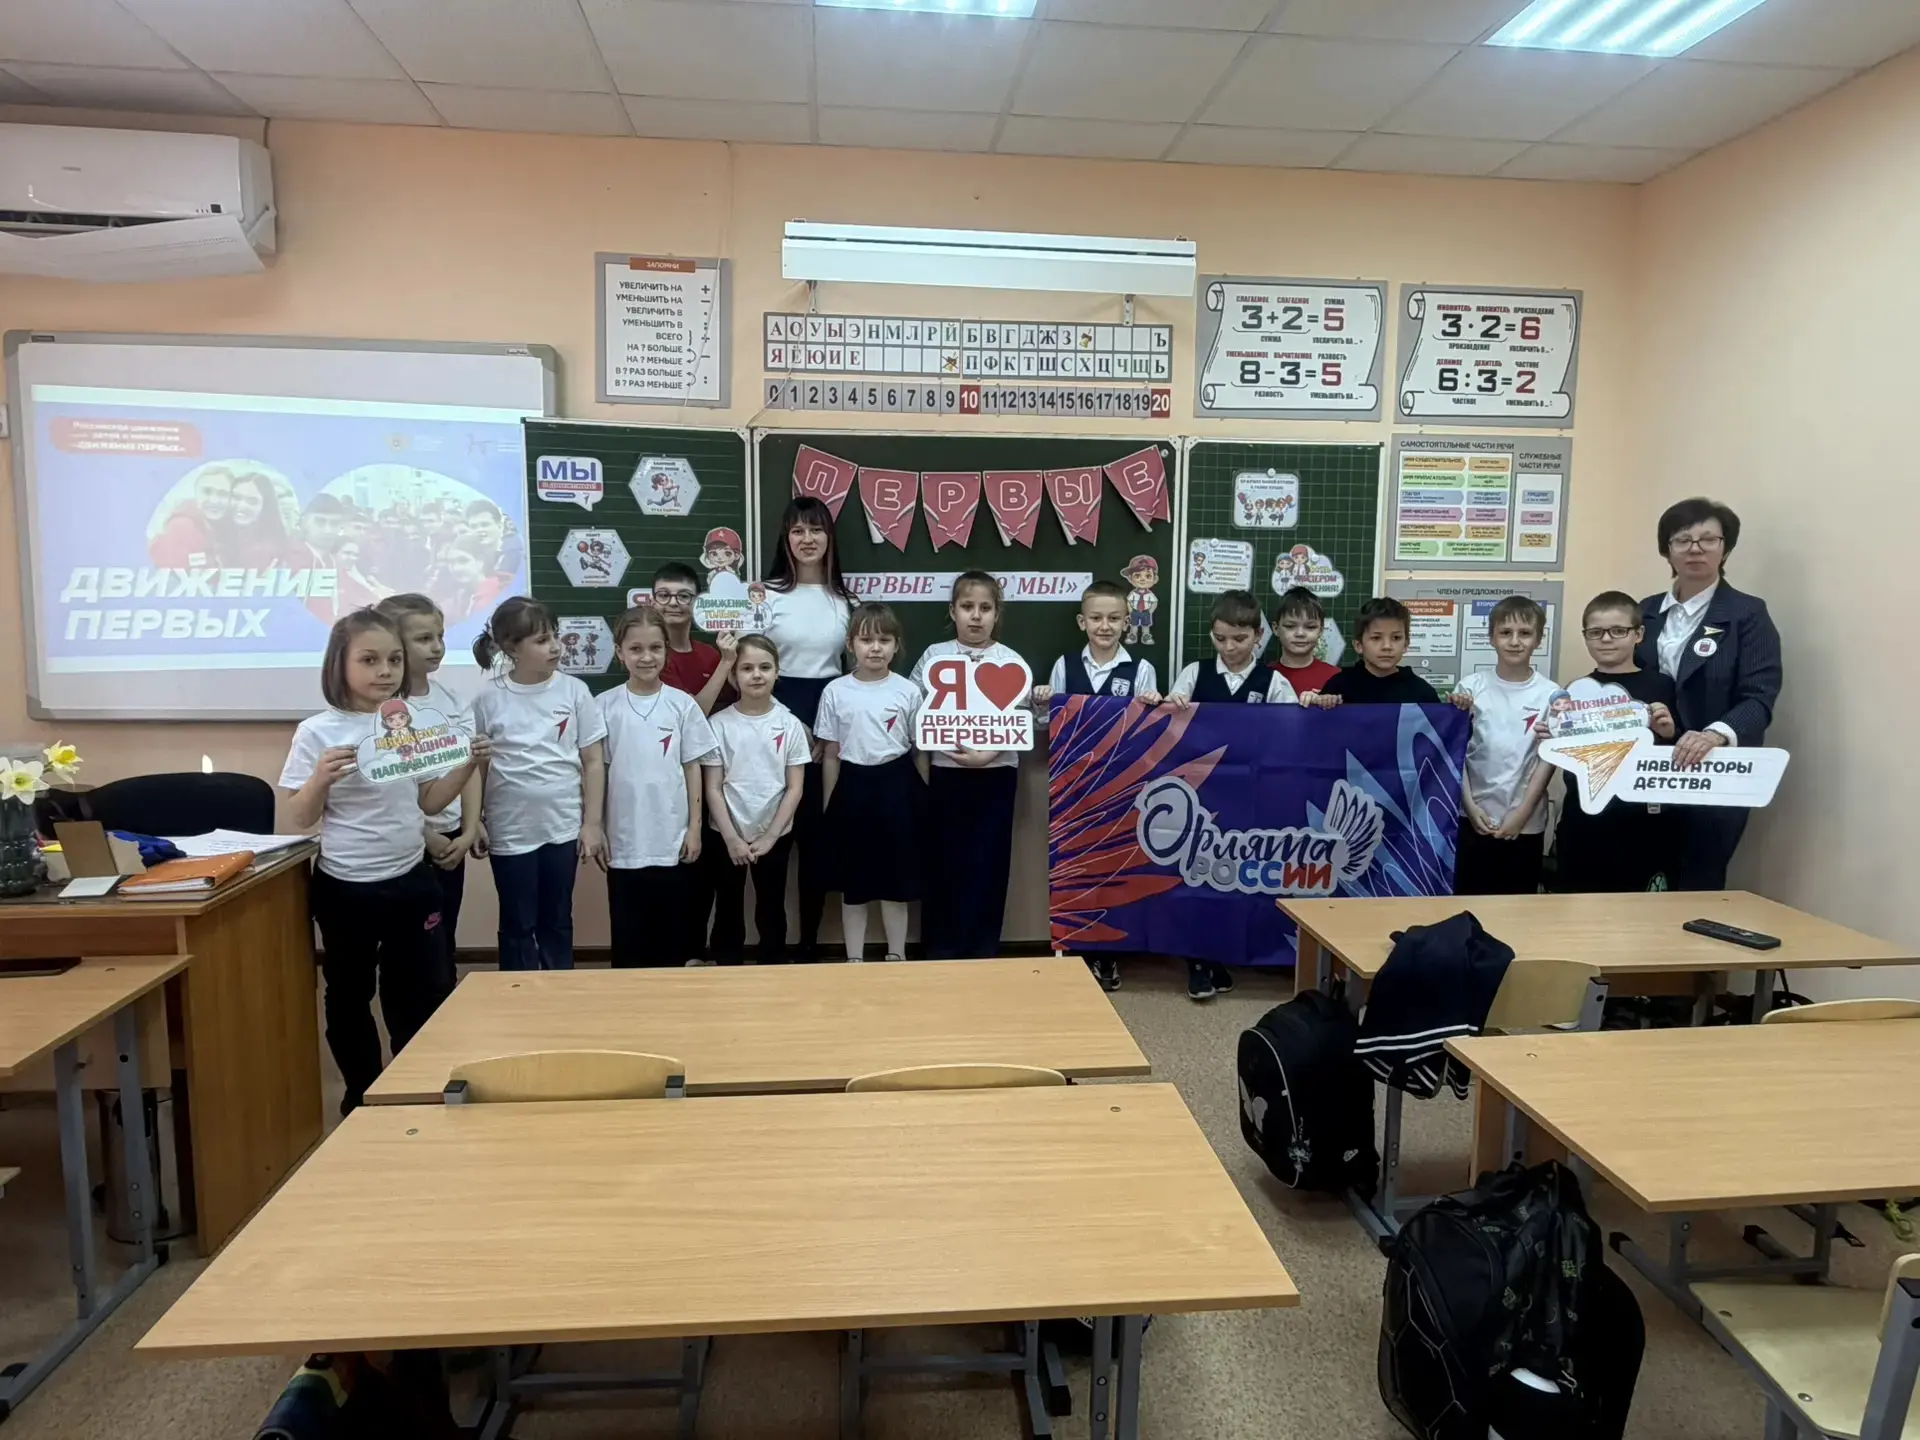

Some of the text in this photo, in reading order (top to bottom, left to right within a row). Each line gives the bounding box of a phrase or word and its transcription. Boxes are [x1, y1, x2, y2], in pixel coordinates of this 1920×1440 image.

[619, 281, 683, 292] УВЕЛИЧИТЬ НА
[616, 293, 683, 304] УМЕНЬШИТЬ НА
[626, 306, 675, 316] УВЕЛИЧИТЬ
[622, 318, 675, 329] УМЕНЬШИТЬ
[656, 332, 683, 341] ВСЕГО
[770, 321, 1167, 347] А О У Ы Э Н М Л Р Й Б В Г Д Ж З Ъ
[627, 343, 639, 351] НА
[647, 344, 683, 353] БОЛЬШЕ
[626, 355, 638, 363] НА
[647, 356, 683, 365] МЕНЬШЕ
[770, 345, 1165, 376] Я Ё Ю И Е П Ф К Т Ш С Х Ц Ч Щ Ь
[630, 367, 646, 375] РАЗ
[647, 368, 683, 377] БОЛЬШЕ
[623, 379, 627, 387] ?
[629, 380, 645, 388] РАЗ
[646, 380, 683, 389] МЕНЬШЕ
[769, 385, 1169, 412] 0 1 2 3 4 5 6 7 8 9 10 11 12 13 14 15 16 17 18 19 20
[1400, 440, 1470, 449] САМОСТОЯТЕЛЬНЫЕ
[1472, 442, 1495, 450] ЧАСТИ
[542, 460, 596, 481] МЫ
[59, 566, 338, 604] ДВИЖЕНИЕ
[1463, 588, 1514, 596] ПРЕДЛОЖЕНИЯ
[64, 607, 270, 641] ПЕРВЫХ
[928, 660, 967, 710] Я
[921, 715, 1026, 728] ДВИЖЕНИЕ
[922, 728, 1028, 745] ПЕРВЫХ
[1633, 776, 1712, 790] ДЕТСТВА
[1142, 781, 1338, 871] Орлята
